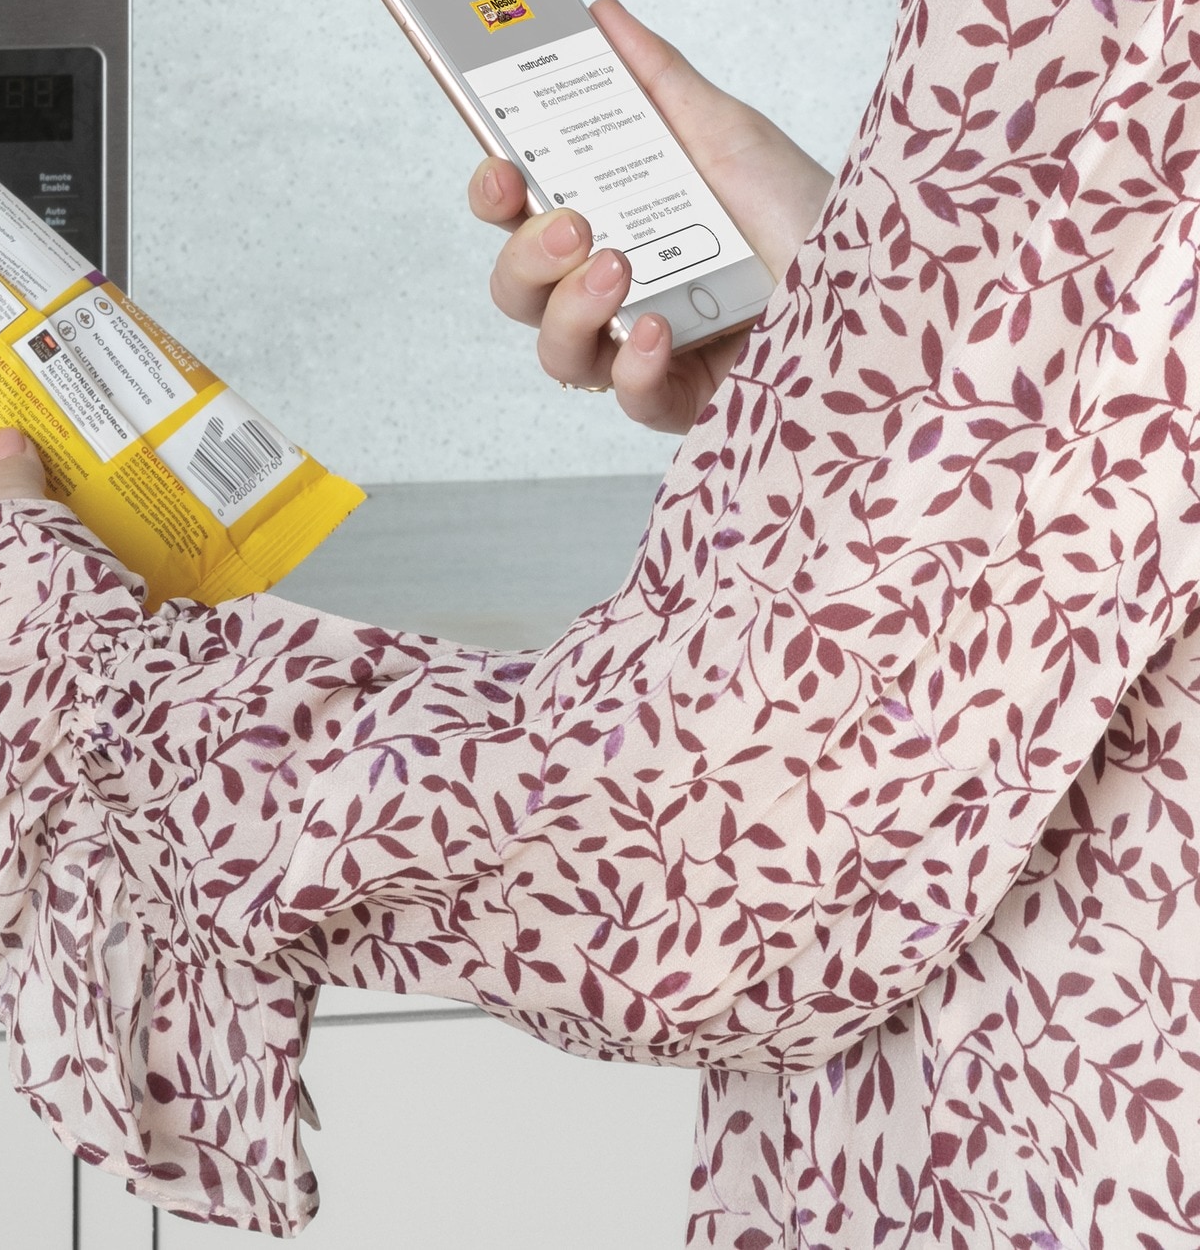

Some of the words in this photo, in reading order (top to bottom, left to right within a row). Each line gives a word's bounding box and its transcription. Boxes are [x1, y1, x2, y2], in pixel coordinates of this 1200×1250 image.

[518, 54, 558, 72] Instructions
[586, 70, 601, 79] Melt
[603, 66, 614, 74] cup
[556, 90, 579, 102] morsels
[583, 77, 612, 93] uncovered
[504, 106, 520, 115] Prep
[560, 116, 601, 135] microwave-safe
[599, 110, 615, 120] bowl
[567, 128, 602, 145] medium-high
[600, 122, 618, 134] (70%)
[616, 117, 634, 129] power
[534, 146, 551, 157] Cook
[574, 144, 593, 155] minute
[39, 173, 72, 182] Remote
[594, 170, 616, 182] morsels
[615, 165, 628, 174] may
[627, 160, 644, 169] retain
[642, 154, 658, 164] some
[657, 150, 664, 158] of
[41, 183, 70, 192] Enable
[562, 190, 578, 200] Note
[599, 183, 613, 193] their
[612, 175, 633, 188] original
[632, 170, 650, 180] shape
[45, 207, 66, 216] Auto
[624, 203, 653, 217] necessary,
[652, 192, 681, 207] microwave
[626, 215, 652, 230] additional
[650, 212, 659, 220] 10
[671, 200, 692, 213] second
[591, 232, 609, 242] Cook
[631, 227, 656, 240] intervals
[658, 246, 682, 261] SEND
[116, 316, 128, 328] NO
[128, 330, 162, 370] ARTIFICIAL
[121, 298, 144, 321] YOU
[160, 338, 194, 372] TRUST
[74, 346, 99, 379] GLUTEN
[97, 378, 114, 399] FREE
[92, 332, 104, 346] NO
[103, 347, 152, 404] PRESERVATIVES
[110, 320, 140, 354] FLAVORS
[138, 354, 150, 367] OR
[148, 366, 175, 399] COLORS
[41, 370, 85, 427] nestlecocoaplan.com
[54, 359, 72, 383] Cocoa
[71, 382, 95, 412] through
[94, 412, 105, 425] the
[61, 354, 100, 403] RESPONSIBLY
[99, 404, 127, 439] SOURCED
[26, 391, 69, 440] DIRECTIONS:
[68, 392, 87, 416] Cocoa
[85, 415, 100, 433] Plan
[17, 409, 30, 424] bowl
[28, 424, 37, 432] on
[35, 431, 50, 446] HIGH
[46, 445, 64, 462] power
[62, 461, 72, 471] for
[20, 400, 30, 411] 3/4
[28, 410, 41, 424] cups
[40, 423, 59, 444] morsels
[63, 450, 89, 481] uncovered,
[142, 446, 173, 479] QUALITY
[172, 478, 185, 495] TIP:
[218, 509, 224, 517] 0
[230, 479, 256, 505] 28000
[256, 456, 283, 482] 21760
